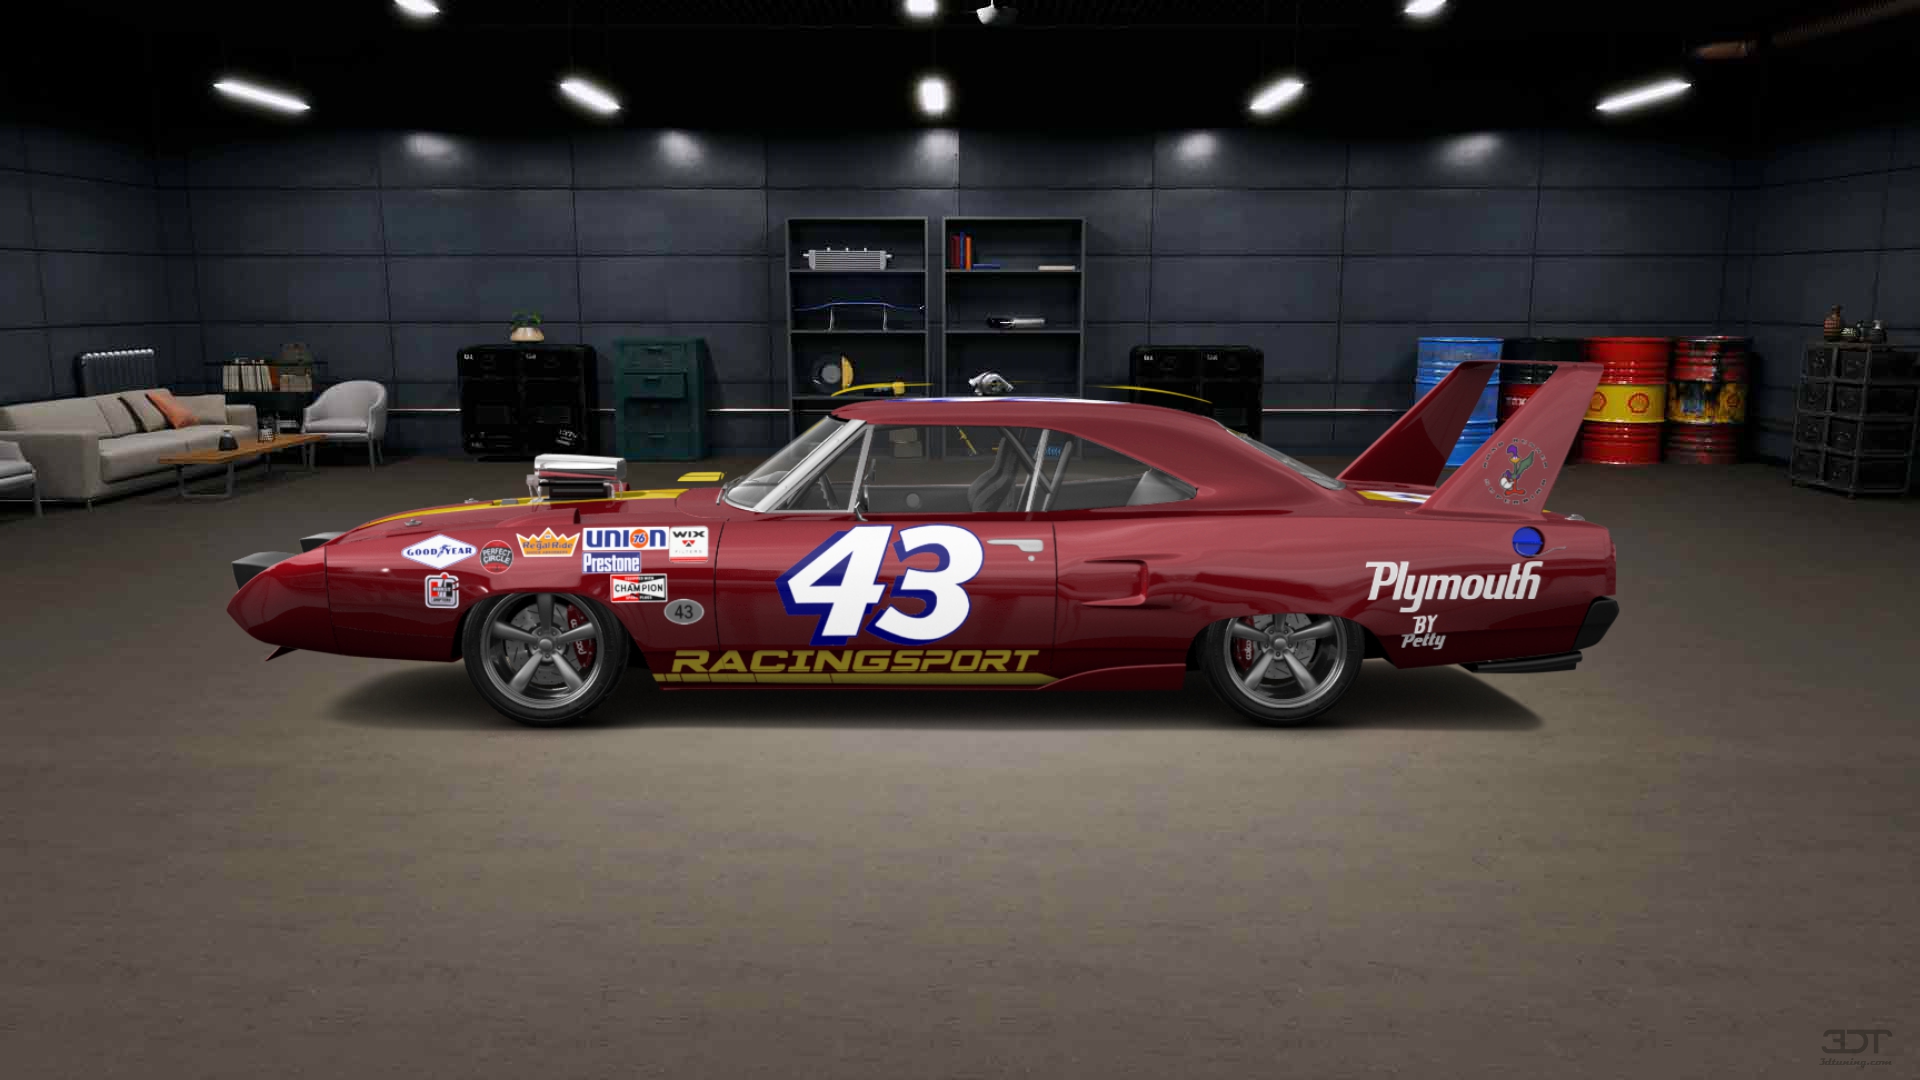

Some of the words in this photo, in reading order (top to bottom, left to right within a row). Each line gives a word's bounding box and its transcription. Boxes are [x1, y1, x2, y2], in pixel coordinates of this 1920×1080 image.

[552, 541, 573, 549] Ride
[633, 534, 646, 543] 76
[407, 546, 472, 557] GOODYEAR
[482, 547, 512, 558] PERFECT
[483, 555, 511, 565] CIRCLE
[583, 552, 640, 573] Prestone
[614, 583, 663, 593] CHAMPION
[775, 524, 984, 645] 43
[1365, 560, 1543, 612] Plymouth
[674, 604, 693, 619] 43
[1412, 614, 1438, 634] BY
[1401, 632, 1446, 650] Petty
[671, 650, 1040, 672] RACINGSPORT
